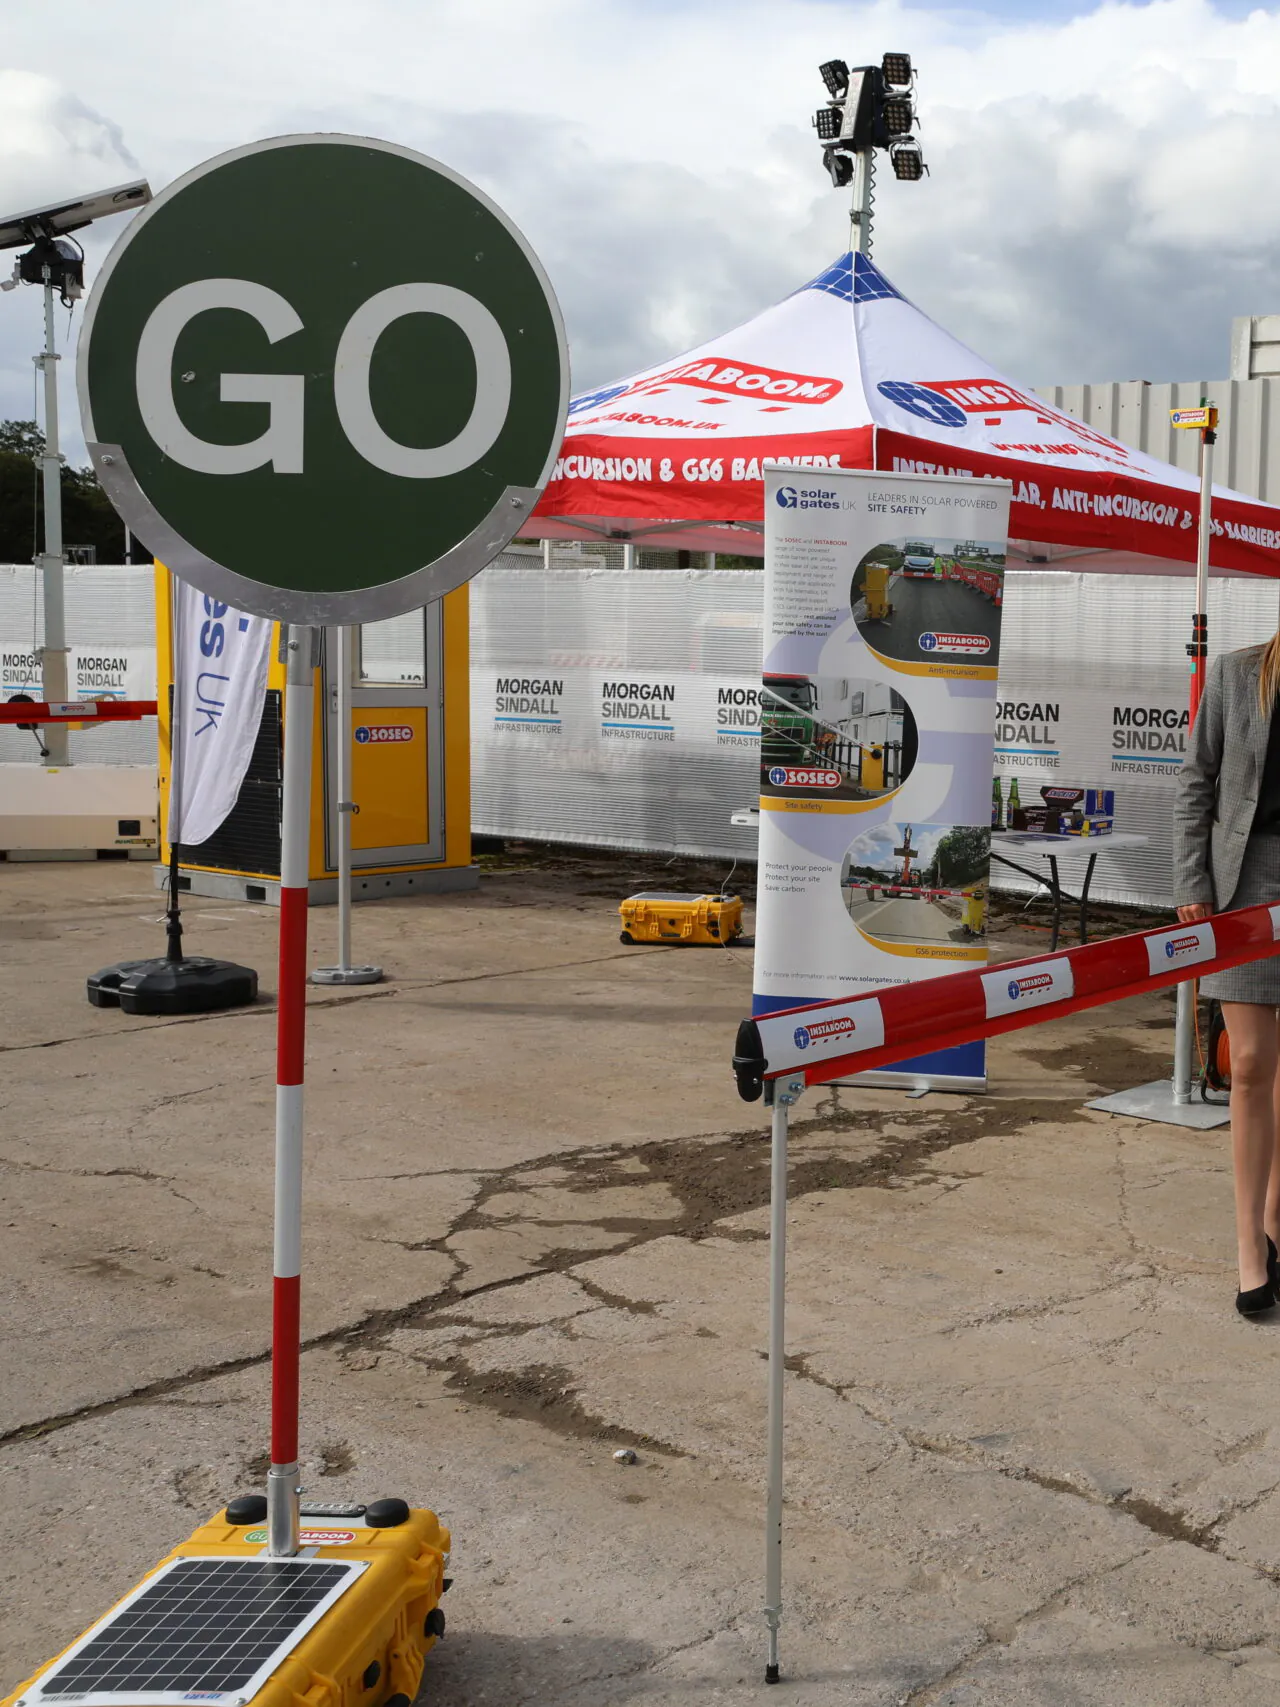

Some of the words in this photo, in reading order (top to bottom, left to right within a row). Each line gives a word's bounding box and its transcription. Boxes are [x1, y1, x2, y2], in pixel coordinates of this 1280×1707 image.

[136, 278, 511, 478] GO
[551, 456, 652, 481] NCURSION
[659, 458, 675, 482] &
[682, 457, 724, 482] GS6
[800, 489, 837, 500] solar
[868, 492, 907, 504] LEADERS
[909, 495, 919, 504] IN
[922, 496, 951, 506] SOLAR
[954, 499, 998, 510] POWERED
[800, 500, 840, 510] gates
[842, 501, 857, 511] UK
[868, 504, 887, 513] SITE
[891, 505, 927, 515] SAFETY
[1052, 487, 1178, 526] ANTI-INCURSION
[1180, 510, 1192, 529] &
[1224, 521, 1280, 549] BARRIERS
[939, 636, 986, 645] INSTABOOM
[3, 654, 41, 667] MORGA
[77, 657, 127, 671] MORGAN
[2, 669, 43, 684] SINDAL
[77, 673, 124, 687] SINDALL
[496, 678, 563, 696] MORGAN
[602, 682, 675, 701] MORGAN
[718, 688, 762, 706] MOR
[195, 672, 230, 737] UK
[495, 697, 559, 715] SINDALL
[602, 702, 671, 721] SINDALL
[717, 708, 762, 727] SIND
[996, 702, 1060, 722] RGAN
[1113, 707, 1190, 729] MORGA
[371, 728, 412, 741] SOSEC
[494, 723, 562, 735] INFRASTRUCTURE
[601, 728, 675, 742] INFRASTRUCTURE
[995, 724, 1055, 745] DALL
[717, 735, 760, 747] INFRASTR
[1112, 729, 1187, 752] SINDAL
[993, 754, 1061, 768] ASTRUCTURE
[1111, 762, 1182, 776] INFRASTRUC
[788, 771, 837, 784] SOSEC
[800, 802, 823, 812] safety
[765, 863, 789, 871] Protect
[765, 873, 789, 881] Protect
[932, 950, 968, 958] protection
[839, 975, 911, 984] www.solargates.co.uk
[1019, 975, 1051, 989] INSTABOOM
[810, 1020, 852, 1037] INSTABOOM
